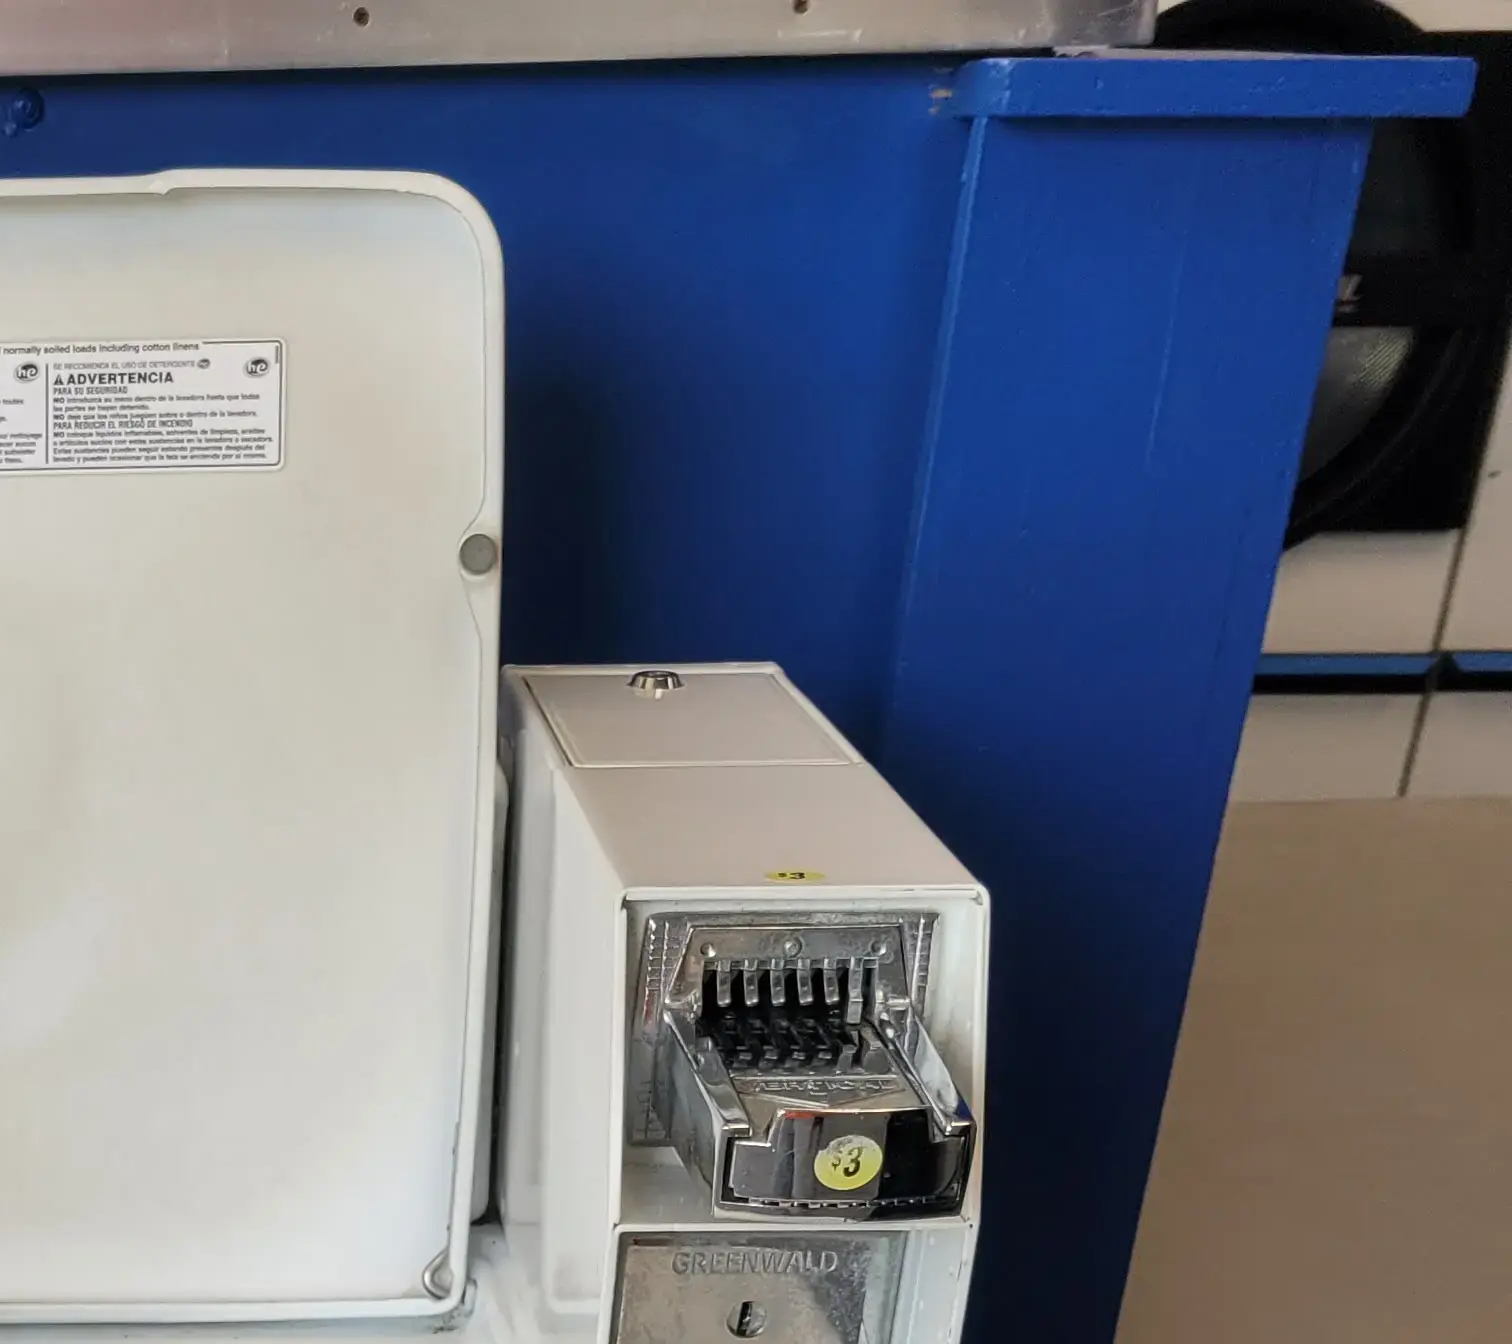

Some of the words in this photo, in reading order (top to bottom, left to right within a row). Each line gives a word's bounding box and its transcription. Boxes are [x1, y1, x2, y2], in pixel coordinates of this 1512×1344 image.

[2, 345, 42, 357] normally
[43, 344, 70, 354] soiled
[72, 344, 97, 353] loads
[98, 342, 140, 355] including
[141, 343, 170, 352] cotton
[172, 341, 200, 350] linens
[67, 371, 174, 385] ADVERTENCIA
[52, 386, 73, 395] PARA
[73, 386, 84, 395] SU
[52, 421, 72, 430] PARA
[107, 420, 116, 429] EL
[117, 419, 146, 429] RIESGO
[146, 419, 158, 428] DE
[831, 1146, 864, 1178] $3
[671, 1250, 838, 1275] GREENWALD
